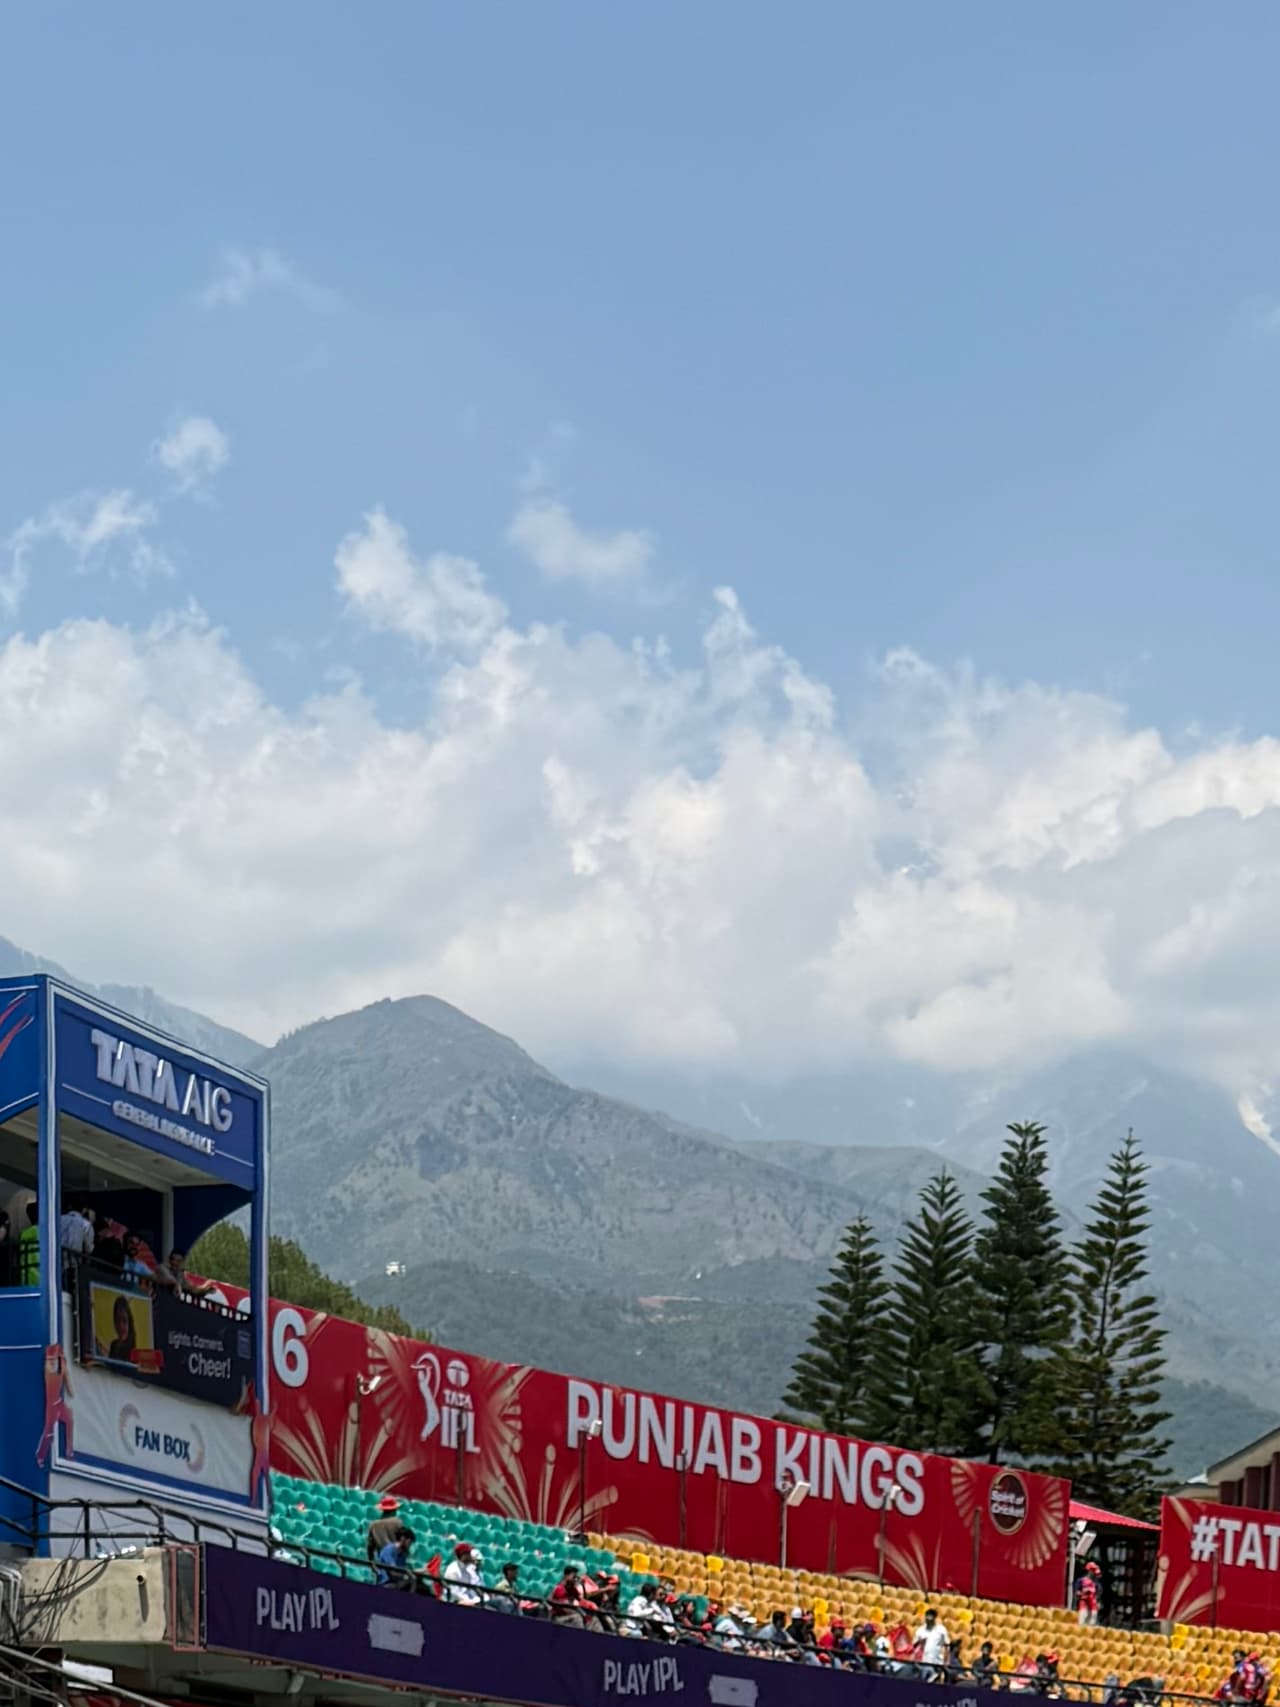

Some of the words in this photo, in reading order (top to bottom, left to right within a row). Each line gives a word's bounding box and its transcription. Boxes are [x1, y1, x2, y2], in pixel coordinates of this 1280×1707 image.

[91, 1028, 180, 1112] TATA
[182, 1073, 233, 1132] AIG
[188, 1353, 231, 1379] Cheer!
[135, 1426, 161, 1453] FAN
[164, 1434, 191, 1463] BOX
[440, 1405, 480, 1454] IPL
[567, 1379, 762, 1485] PUNJAB
[775, 1426, 925, 1516] KINGS
[256, 1587, 306, 1632] PLAY
[307, 1586, 340, 1631] IPL
[603, 1658, 651, 1696] PLAY
[652, 1656, 684, 1691] IPL
